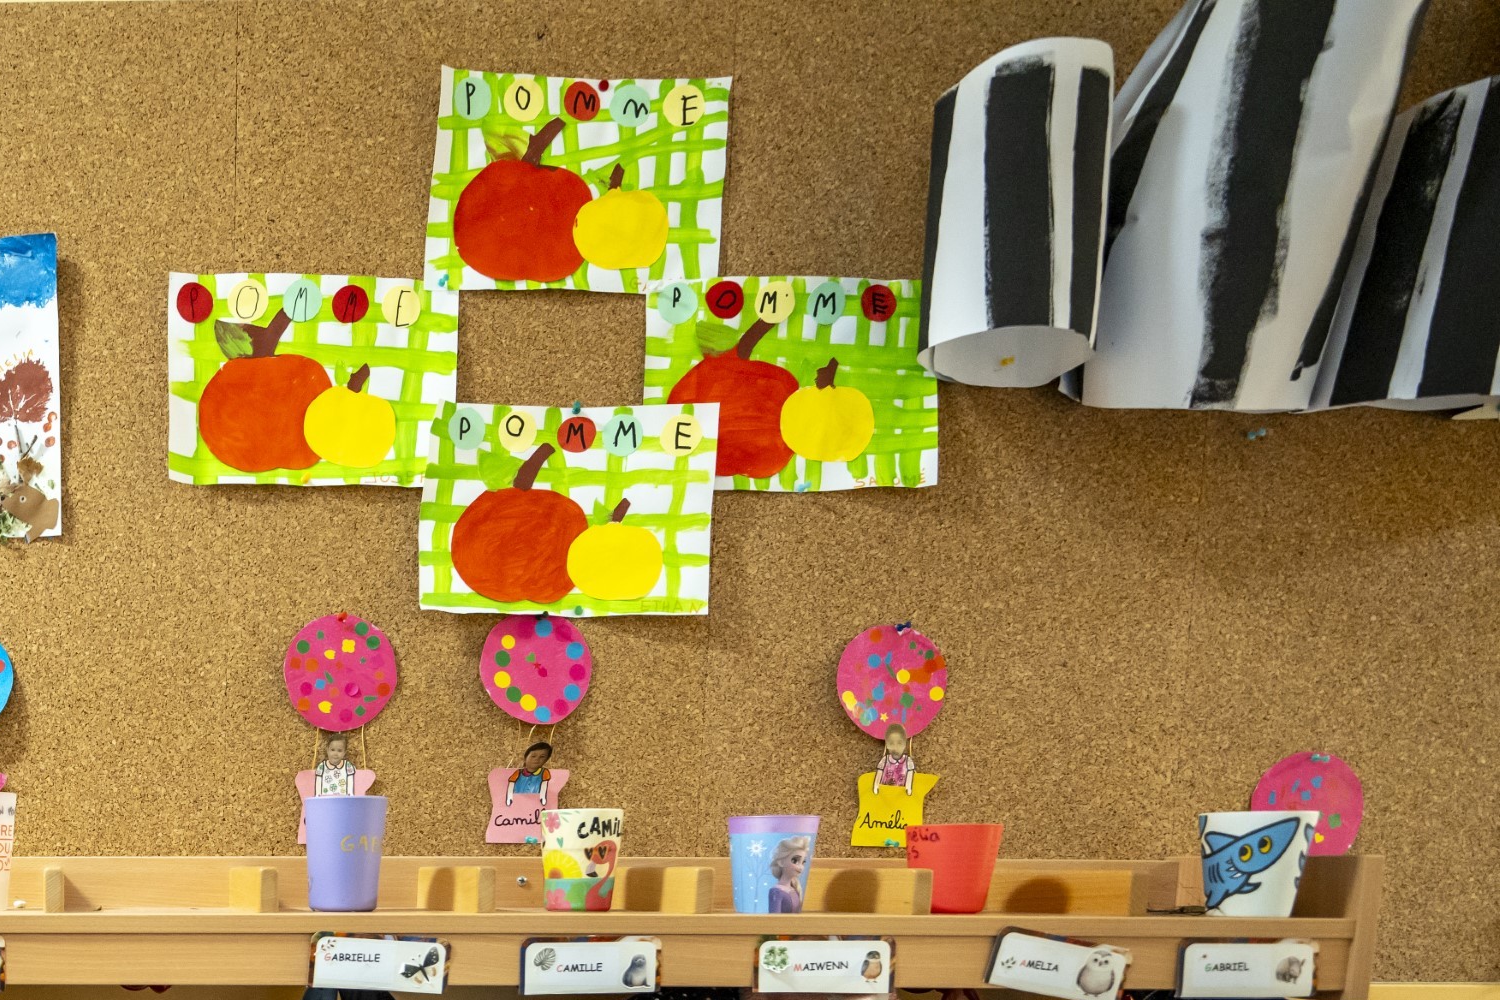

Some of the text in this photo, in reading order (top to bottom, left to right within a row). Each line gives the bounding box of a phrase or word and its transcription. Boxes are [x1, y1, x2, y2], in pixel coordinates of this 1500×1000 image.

[494, 809, 546, 827] Camil
[324, 951, 381, 963] GABRIELLE
[556, 962, 603, 973] CAMILLE
[793, 961, 849, 972] MAIWENN
[1019, 960, 1059, 973] AMELIA
[1204, 961, 1250, 973] GABRIEL
